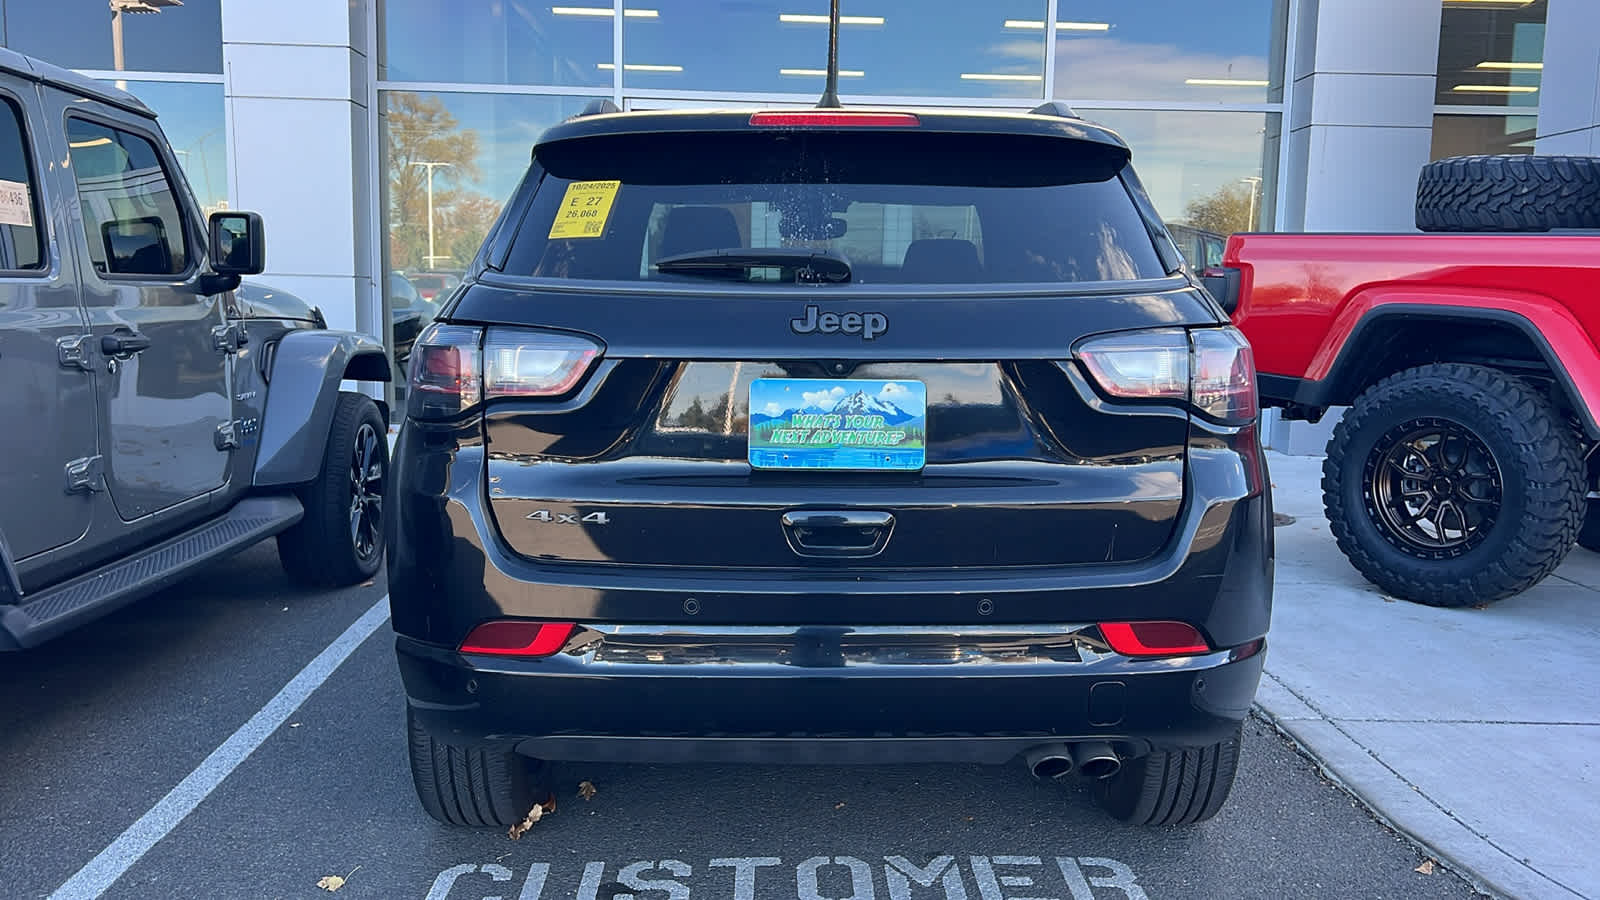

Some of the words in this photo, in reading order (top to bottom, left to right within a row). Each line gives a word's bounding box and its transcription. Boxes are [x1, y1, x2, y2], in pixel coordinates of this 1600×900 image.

[570, 197, 580, 206] E
[586, 196, 602, 206] 27
[790, 304, 888, 340] Jeep
[791, 414, 841, 429] WHAT'S
[845, 414, 885, 430] YOUR
[770, 429, 812, 444] NEXT
[810, 430, 905, 446] ADVENTURE?
[526, 510, 610, 524] 4x4
[424, 855, 1150, 900] CUSTOMER
